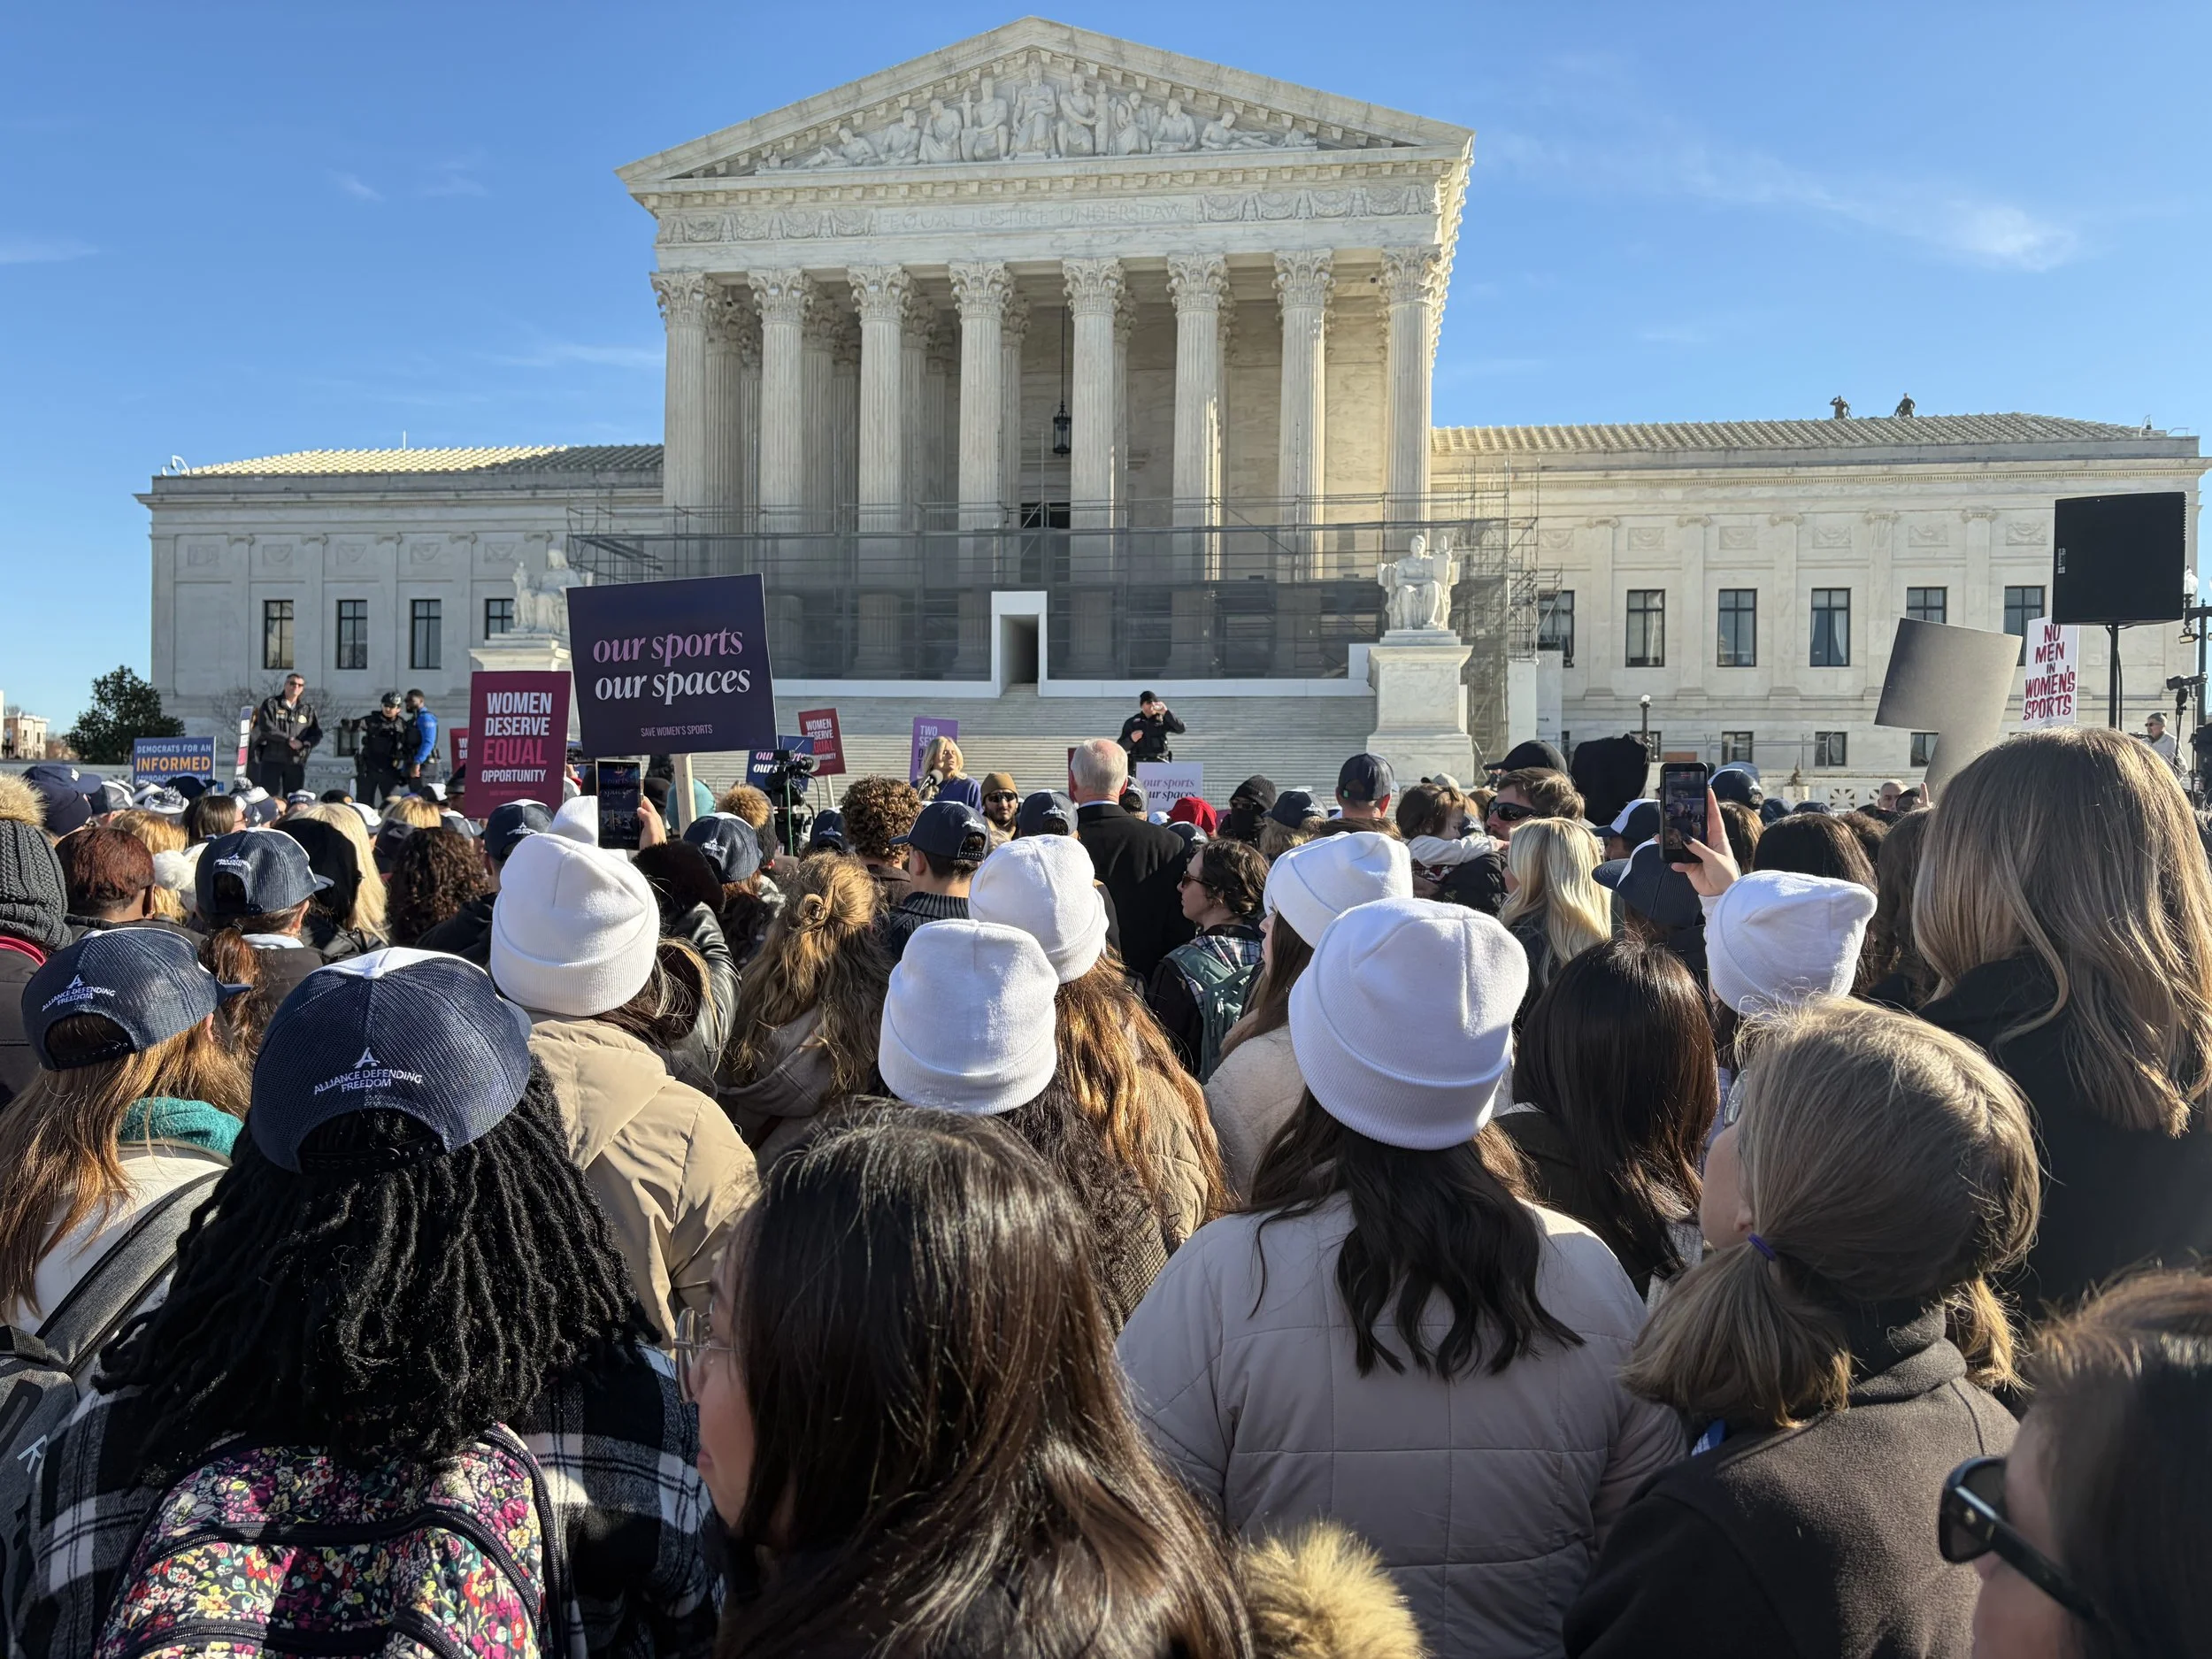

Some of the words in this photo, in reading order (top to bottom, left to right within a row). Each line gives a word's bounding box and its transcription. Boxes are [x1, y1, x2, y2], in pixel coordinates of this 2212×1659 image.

[888, 211, 964, 229] EQUAL
[972, 209, 1048, 227] JUSTICE
[1058, 204, 1131, 222] UNDER
[1141, 203, 1183, 220] LAW
[2044, 624, 2061, 643] NO
[593, 636, 646, 664] our
[650, 626, 743, 667] sports
[2035, 641, 2065, 664] MEN
[2047, 663, 2055, 674] IN
[595, 674, 648, 701] our
[652, 669, 750, 705] spaces
[2024, 665, 2076, 699] WOMEN'S
[487, 692, 552, 714] WOMEN
[2023, 695, 2072, 721] SPORTS
[484, 717, 549, 736] DESERVE
[641, 726, 656, 737] SAVE
[657, 725, 687, 736] WOMEN'S
[687, 724, 713, 735] SPORTS
[806, 718, 832, 731] WOMEN
[920, 726, 938, 736] TWO
[136, 744, 180, 754] DEMOCRATS
[182, 743, 198, 753] FOR
[200, 743, 211, 752] AN
[482, 738, 547, 766] EQUAL
[136, 756, 211, 772] INFORMED
[753, 764, 772, 773] our
[481, 769, 547, 783] OPPORTUNITY
[1143, 779, 1163, 787] our
[1163, 778, 1194, 790] sports
[57, 992, 94, 1006] FREEDOM
[71, 986, 116, 997] DEFENDING
[314, 1071, 361, 1095] ALLIANCE
[363, 1069, 423, 1084] DEFENDING
[341, 1079, 392, 1093] FREEDOM
